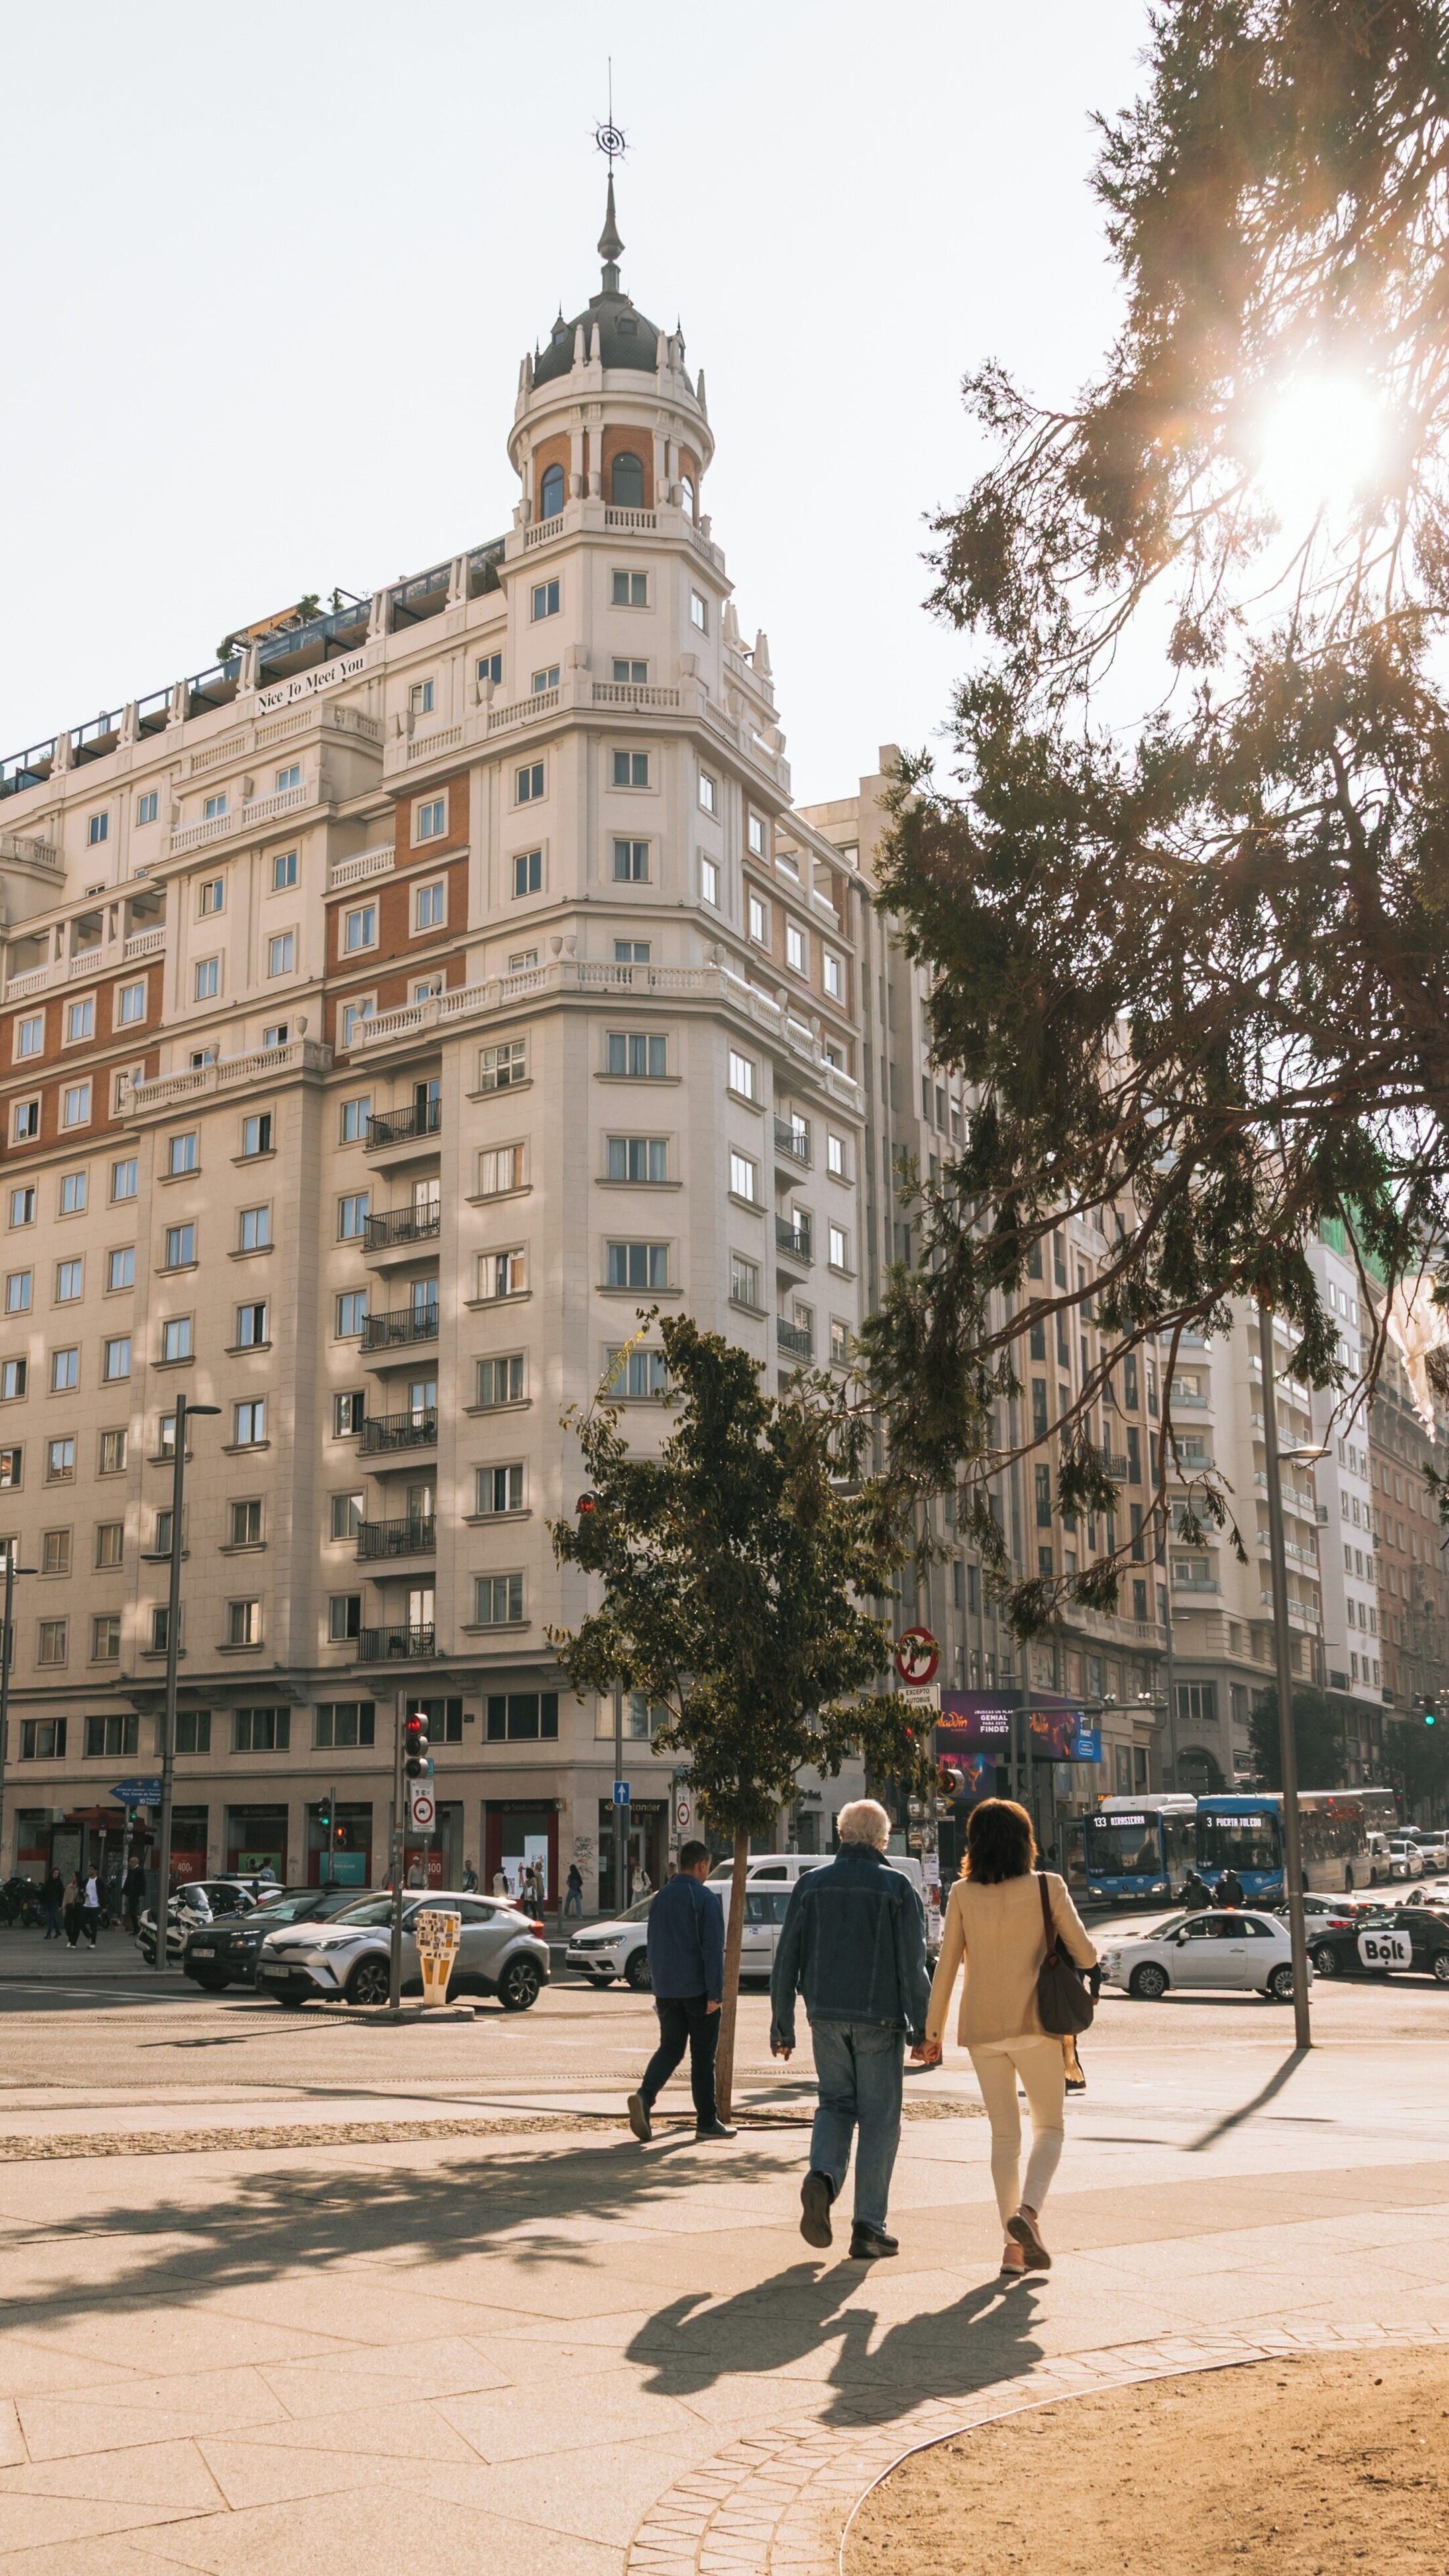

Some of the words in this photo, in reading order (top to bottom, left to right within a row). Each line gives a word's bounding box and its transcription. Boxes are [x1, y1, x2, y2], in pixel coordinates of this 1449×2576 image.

[258, 692, 283, 711] Nice
[286, 682, 301, 698] To
[306, 667, 335, 691] Meet
[339, 658, 364, 676] You
[629, 1803, 660, 1811] tander
[1093, 1817, 1106, 1827] 133
[1207, 1817, 1212, 1827] 3
[1216, 1818, 1238, 1827] PUERTA
[1240, 1818, 1261, 1827] TOLEDO
[1364, 1939, 1404, 1960] Bolt
